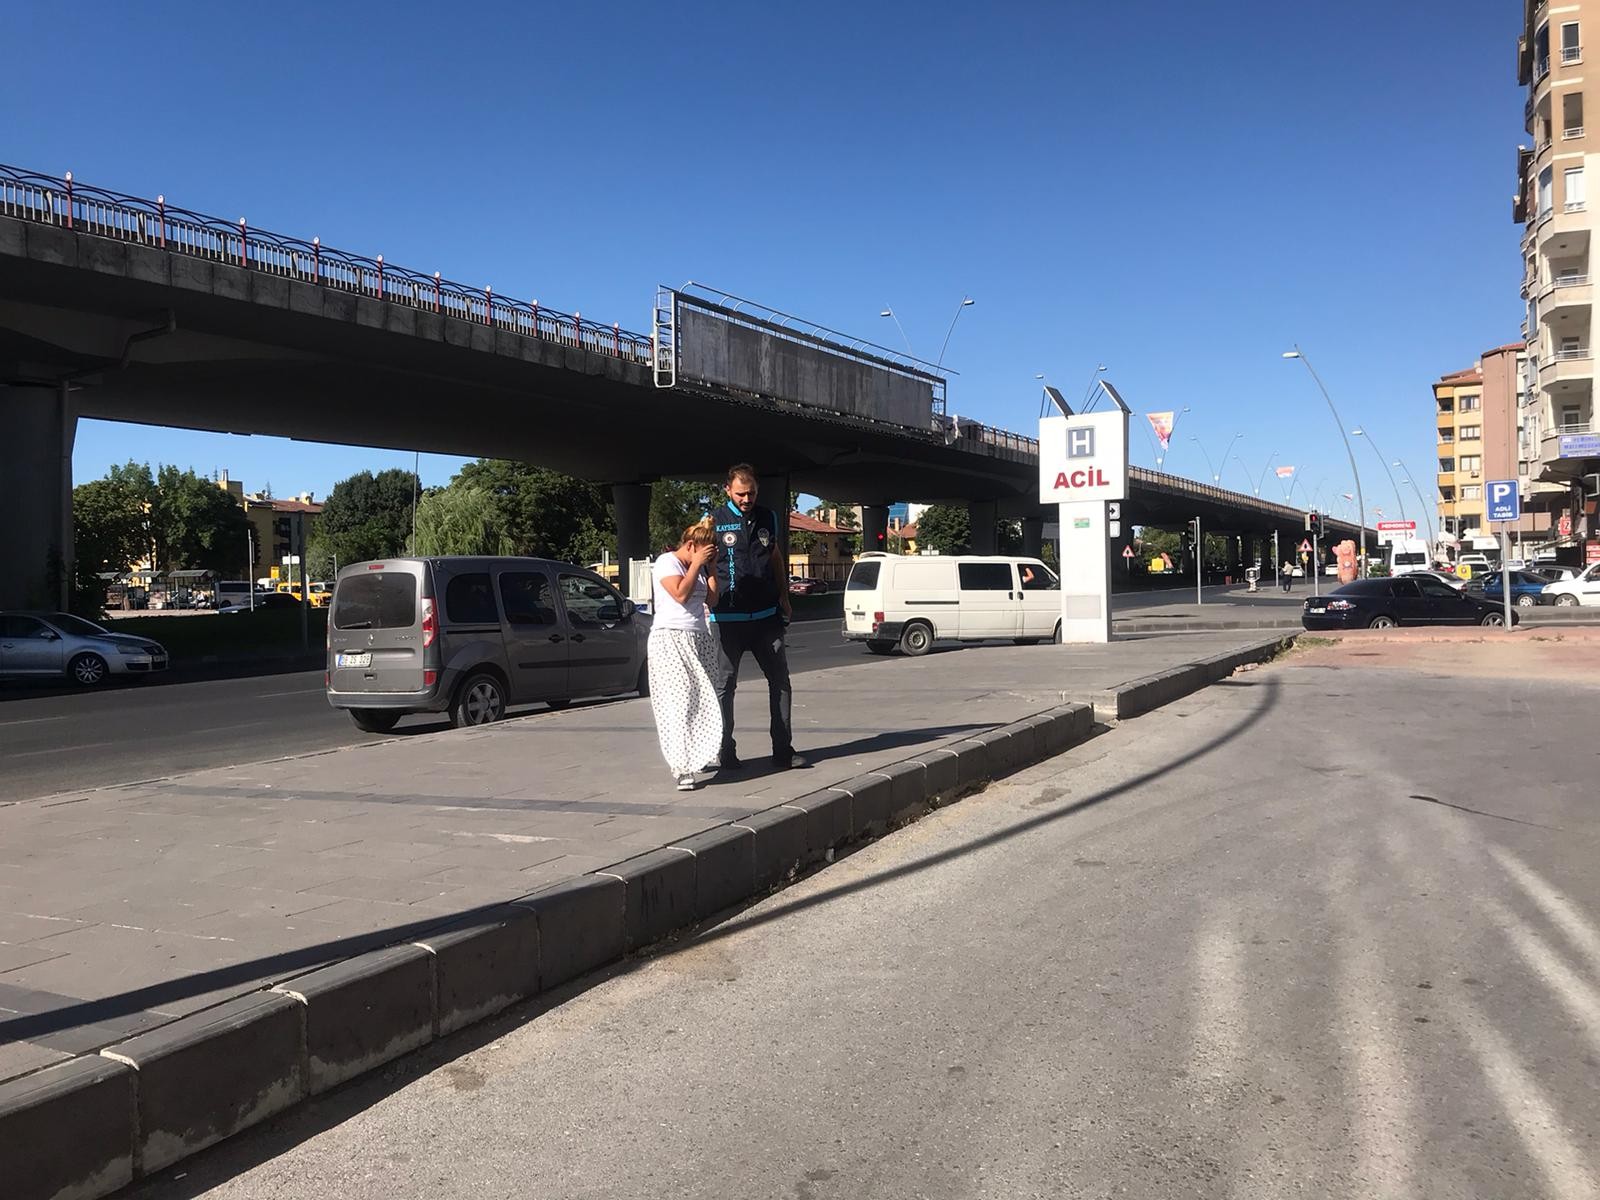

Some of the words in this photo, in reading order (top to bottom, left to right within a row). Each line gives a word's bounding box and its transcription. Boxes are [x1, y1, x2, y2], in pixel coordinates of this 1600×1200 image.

[1072, 430, 1090, 455] H
[1053, 466, 1110, 489] ACİL
[1494, 484, 1511, 503] P
